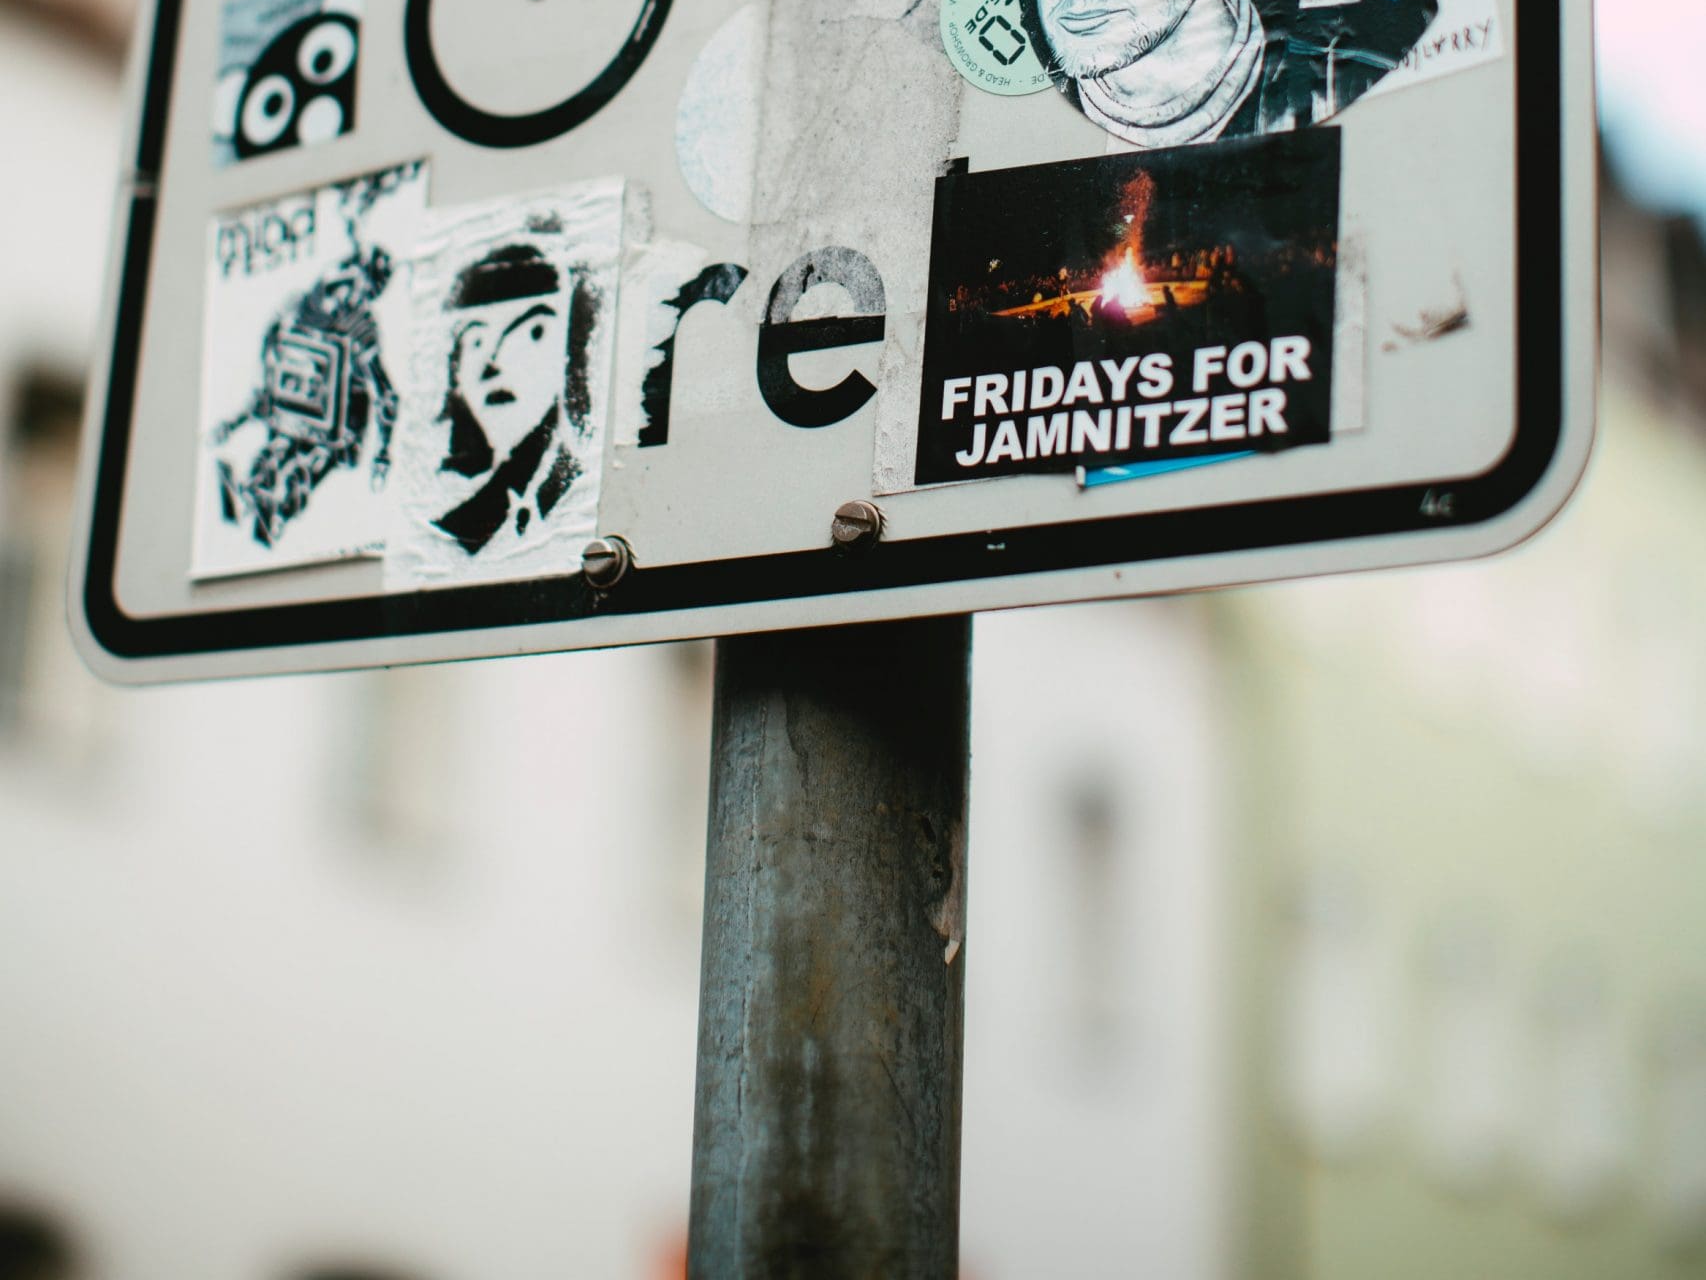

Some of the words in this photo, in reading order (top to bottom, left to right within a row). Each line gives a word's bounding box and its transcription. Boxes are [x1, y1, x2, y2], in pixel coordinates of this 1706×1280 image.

[985, 73, 1011, 86] HEAD
[940, 351, 1174, 421] FRIDAYS
[1192, 334, 1312, 393] FOR
[954, 388, 1288, 468] JAMNITZER
